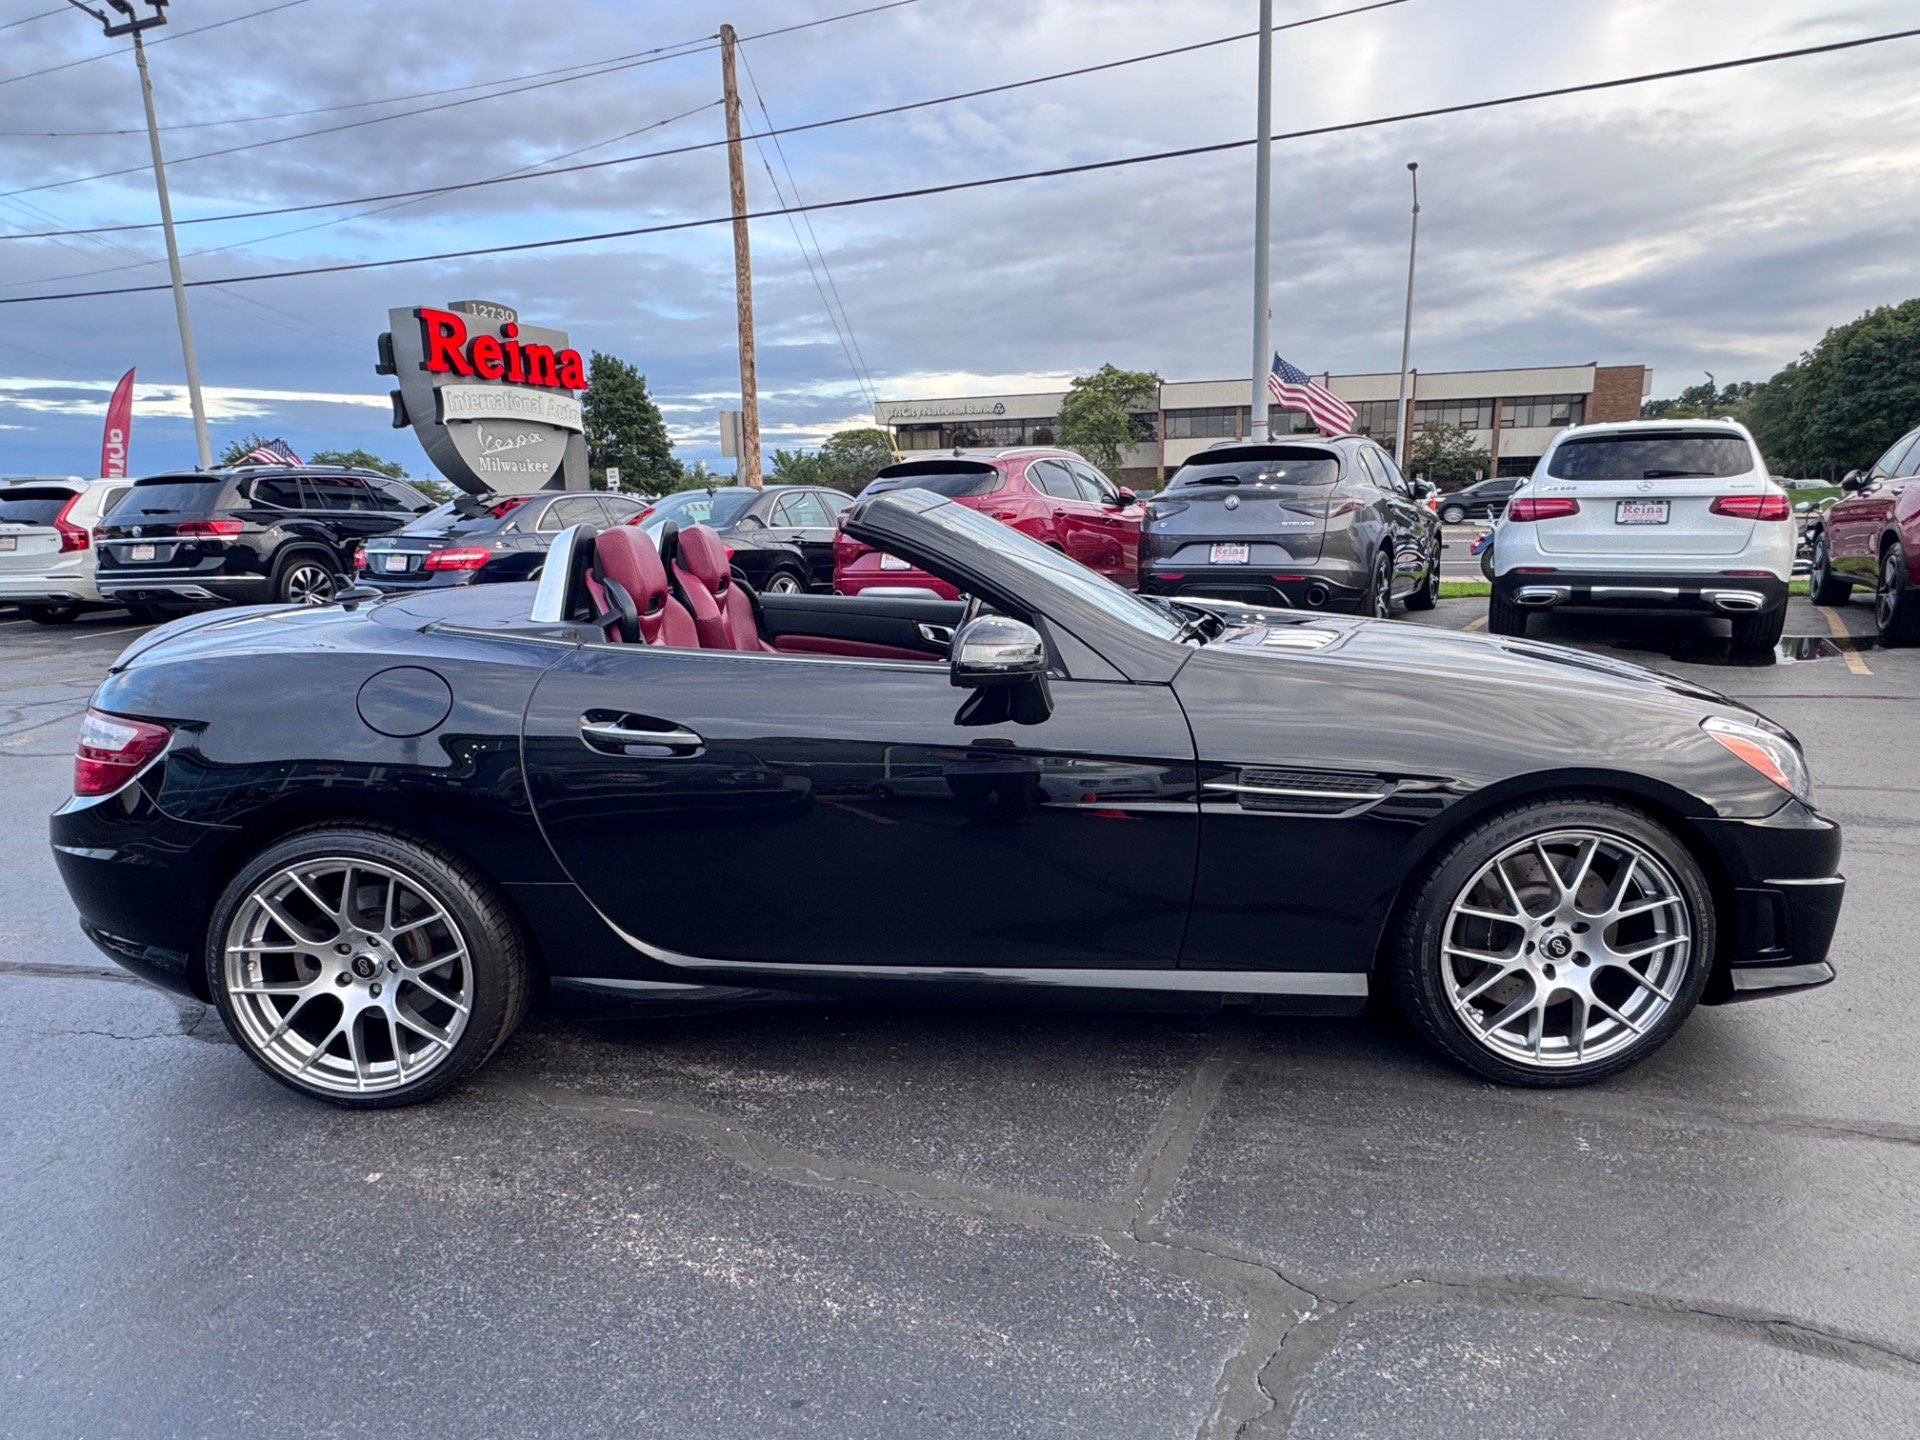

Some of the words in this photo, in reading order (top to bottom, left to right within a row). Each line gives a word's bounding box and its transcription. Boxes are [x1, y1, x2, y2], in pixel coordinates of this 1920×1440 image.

[472, 303, 515, 322] 12730
[419, 307, 589, 390] Reina
[446, 391, 544, 415] International
[548, 399, 579, 423] Auto
[476, 423, 546, 456] Vespa
[478, 456, 550, 474] Milwaukee
[1623, 503, 1664, 514] Reina
[1215, 546, 1245, 555] Reina
